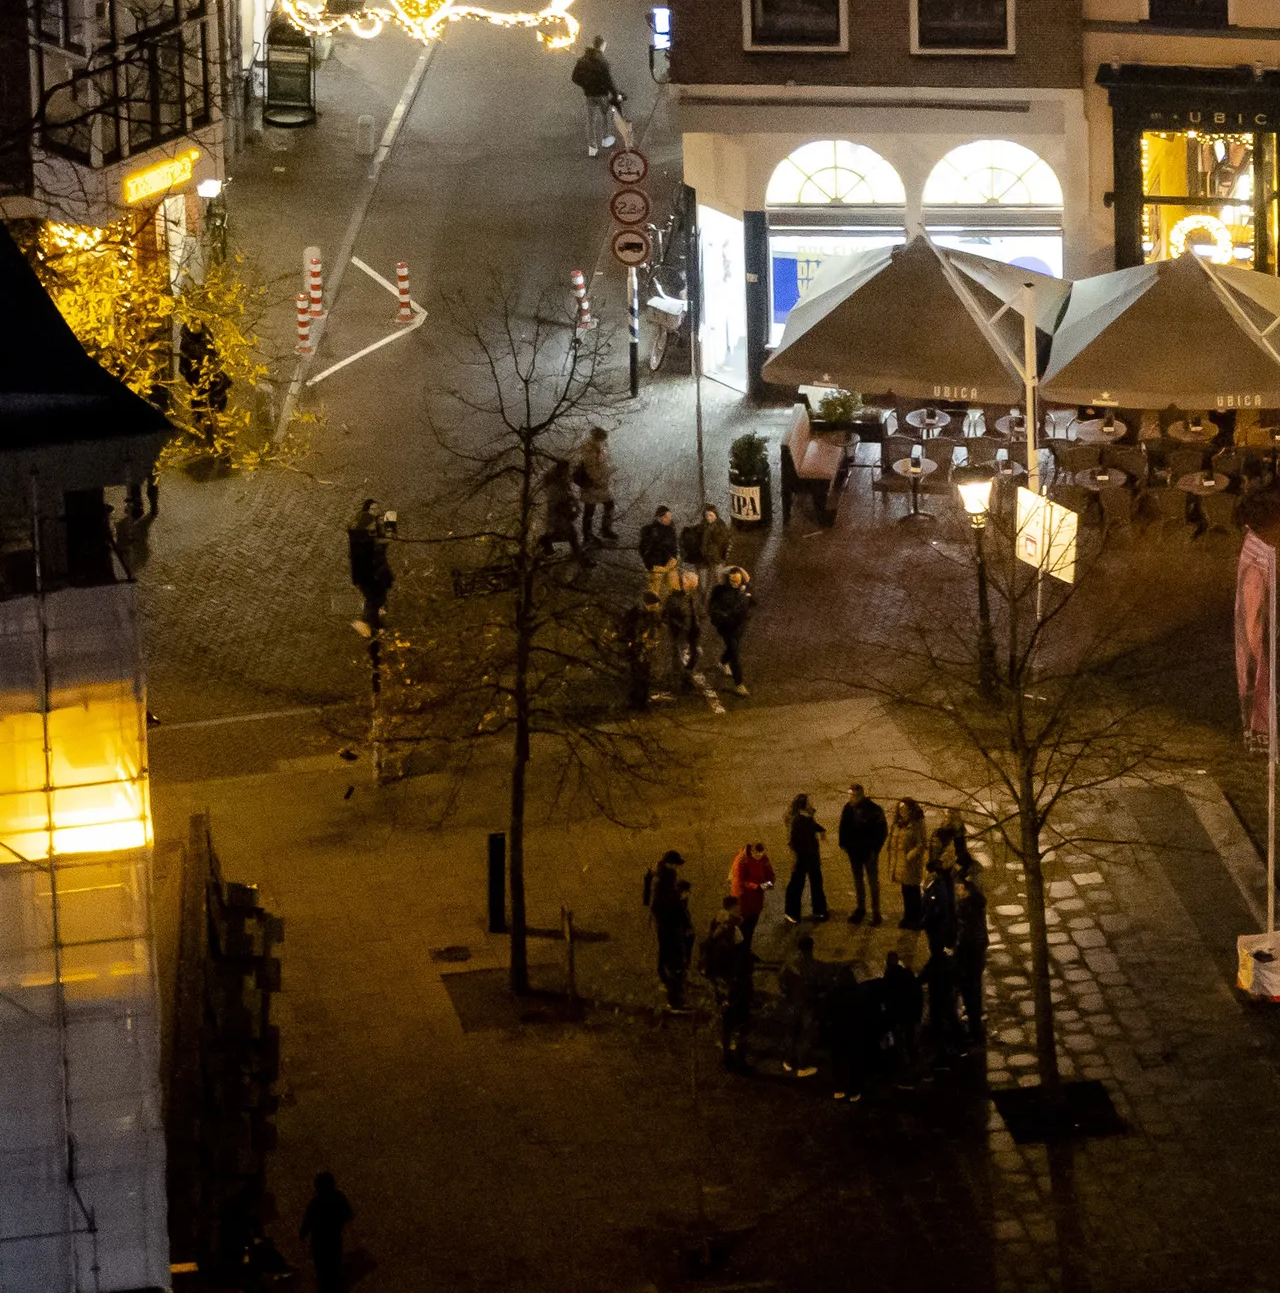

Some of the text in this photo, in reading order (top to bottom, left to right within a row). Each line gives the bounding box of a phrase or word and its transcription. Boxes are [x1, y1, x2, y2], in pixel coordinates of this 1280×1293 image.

[933, 385, 979, 399] UBICA
[1217, 394, 1262, 407] UBICA
[730, 493, 760, 516] IPA
